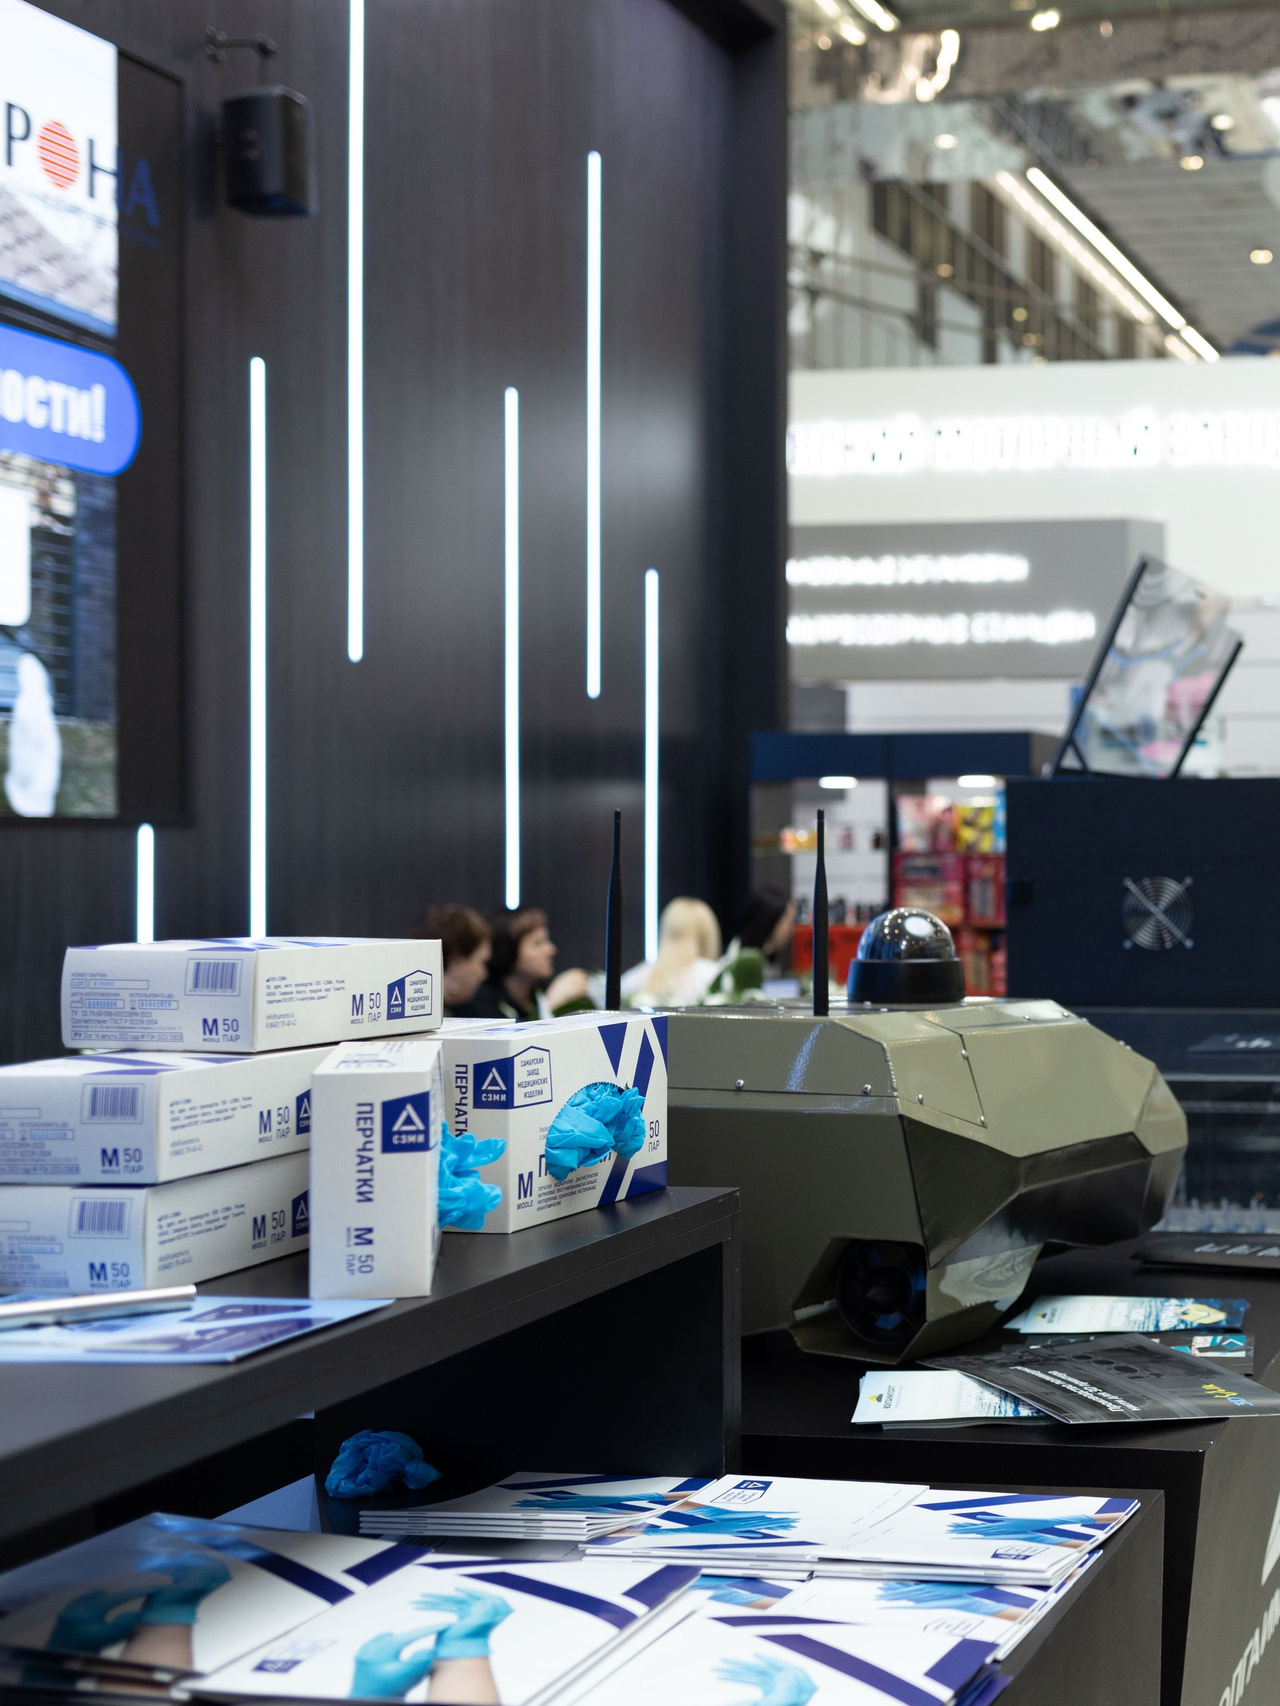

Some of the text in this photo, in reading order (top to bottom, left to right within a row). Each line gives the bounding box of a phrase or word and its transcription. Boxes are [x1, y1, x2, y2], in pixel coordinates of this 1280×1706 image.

[369, 992, 381, 1009] 50
[222, 1018, 239, 1032] 50
[368, 1013, 382, 1023] ПАР
[520, 1056, 544, 1067] САМАРСКИЙ
[526, 1068, 540, 1077] ЗАВОД
[517, 1077, 548, 1089] МЕДИЦИНСКИХ
[454, 1064, 469, 1138] ПЕРЧАТК
[481, 1093, 507, 1101] СЗМИ
[523, 1089, 544, 1099] ИЗДЕЛИЙ
[277, 1106, 290, 1125] 50
[649, 1120, 660, 1138] 50
[392, 1133, 425, 1145] СЗМИ
[648, 1140, 660, 1152] ПАР
[123, 1148, 143, 1162] 50
[356, 1102, 375, 1203] ПЕРЧАТКИ
[517, 1199, 534, 1210] MIDDLE
[271, 1210, 286, 1230] 50
[111, 1263, 130, 1277] 50
[357, 1254, 374, 1274] 50
